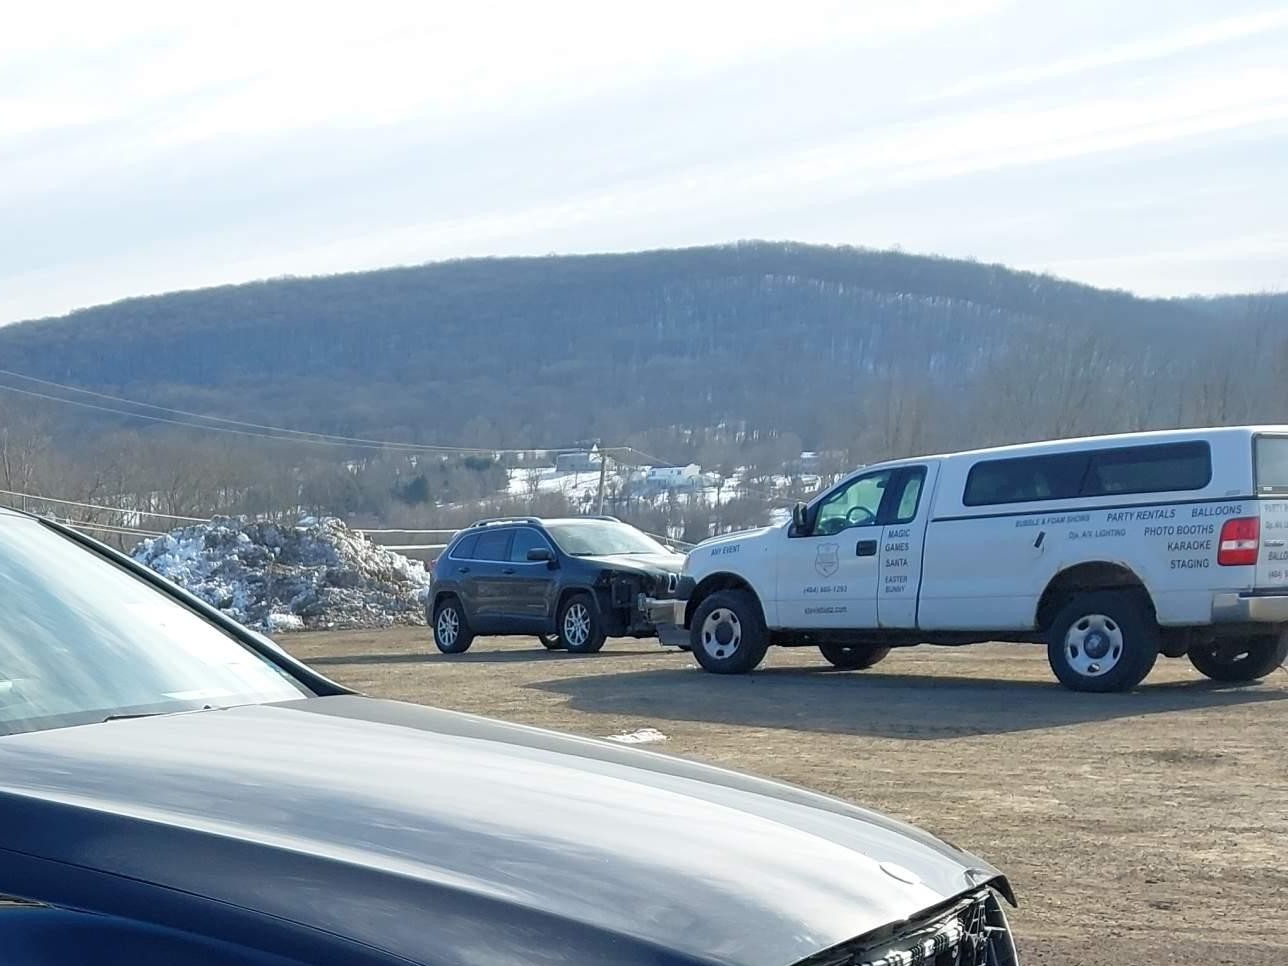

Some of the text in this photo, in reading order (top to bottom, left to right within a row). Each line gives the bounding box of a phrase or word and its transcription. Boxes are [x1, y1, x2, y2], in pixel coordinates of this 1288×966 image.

[1106, 509, 1176, 523] PARTY RENTALS
[1191, 505, 1242, 518] BALLOONS
[1047, 516, 1066, 525] FOAM
[888, 529, 911, 538] MAGIC
[1095, 528, 1127, 538] LIGHTING
[1144, 524, 1214, 537] PHOTO BOOTHS
[711, 544, 740, 556] ANY EVENT
[885, 543, 910, 552] GAMES
[1167, 540, 1211, 551] KARAOKE
[885, 559, 908, 568] SANTA
[1170, 558, 1210, 569] STAGING
[885, 576, 907, 584] EASTER
